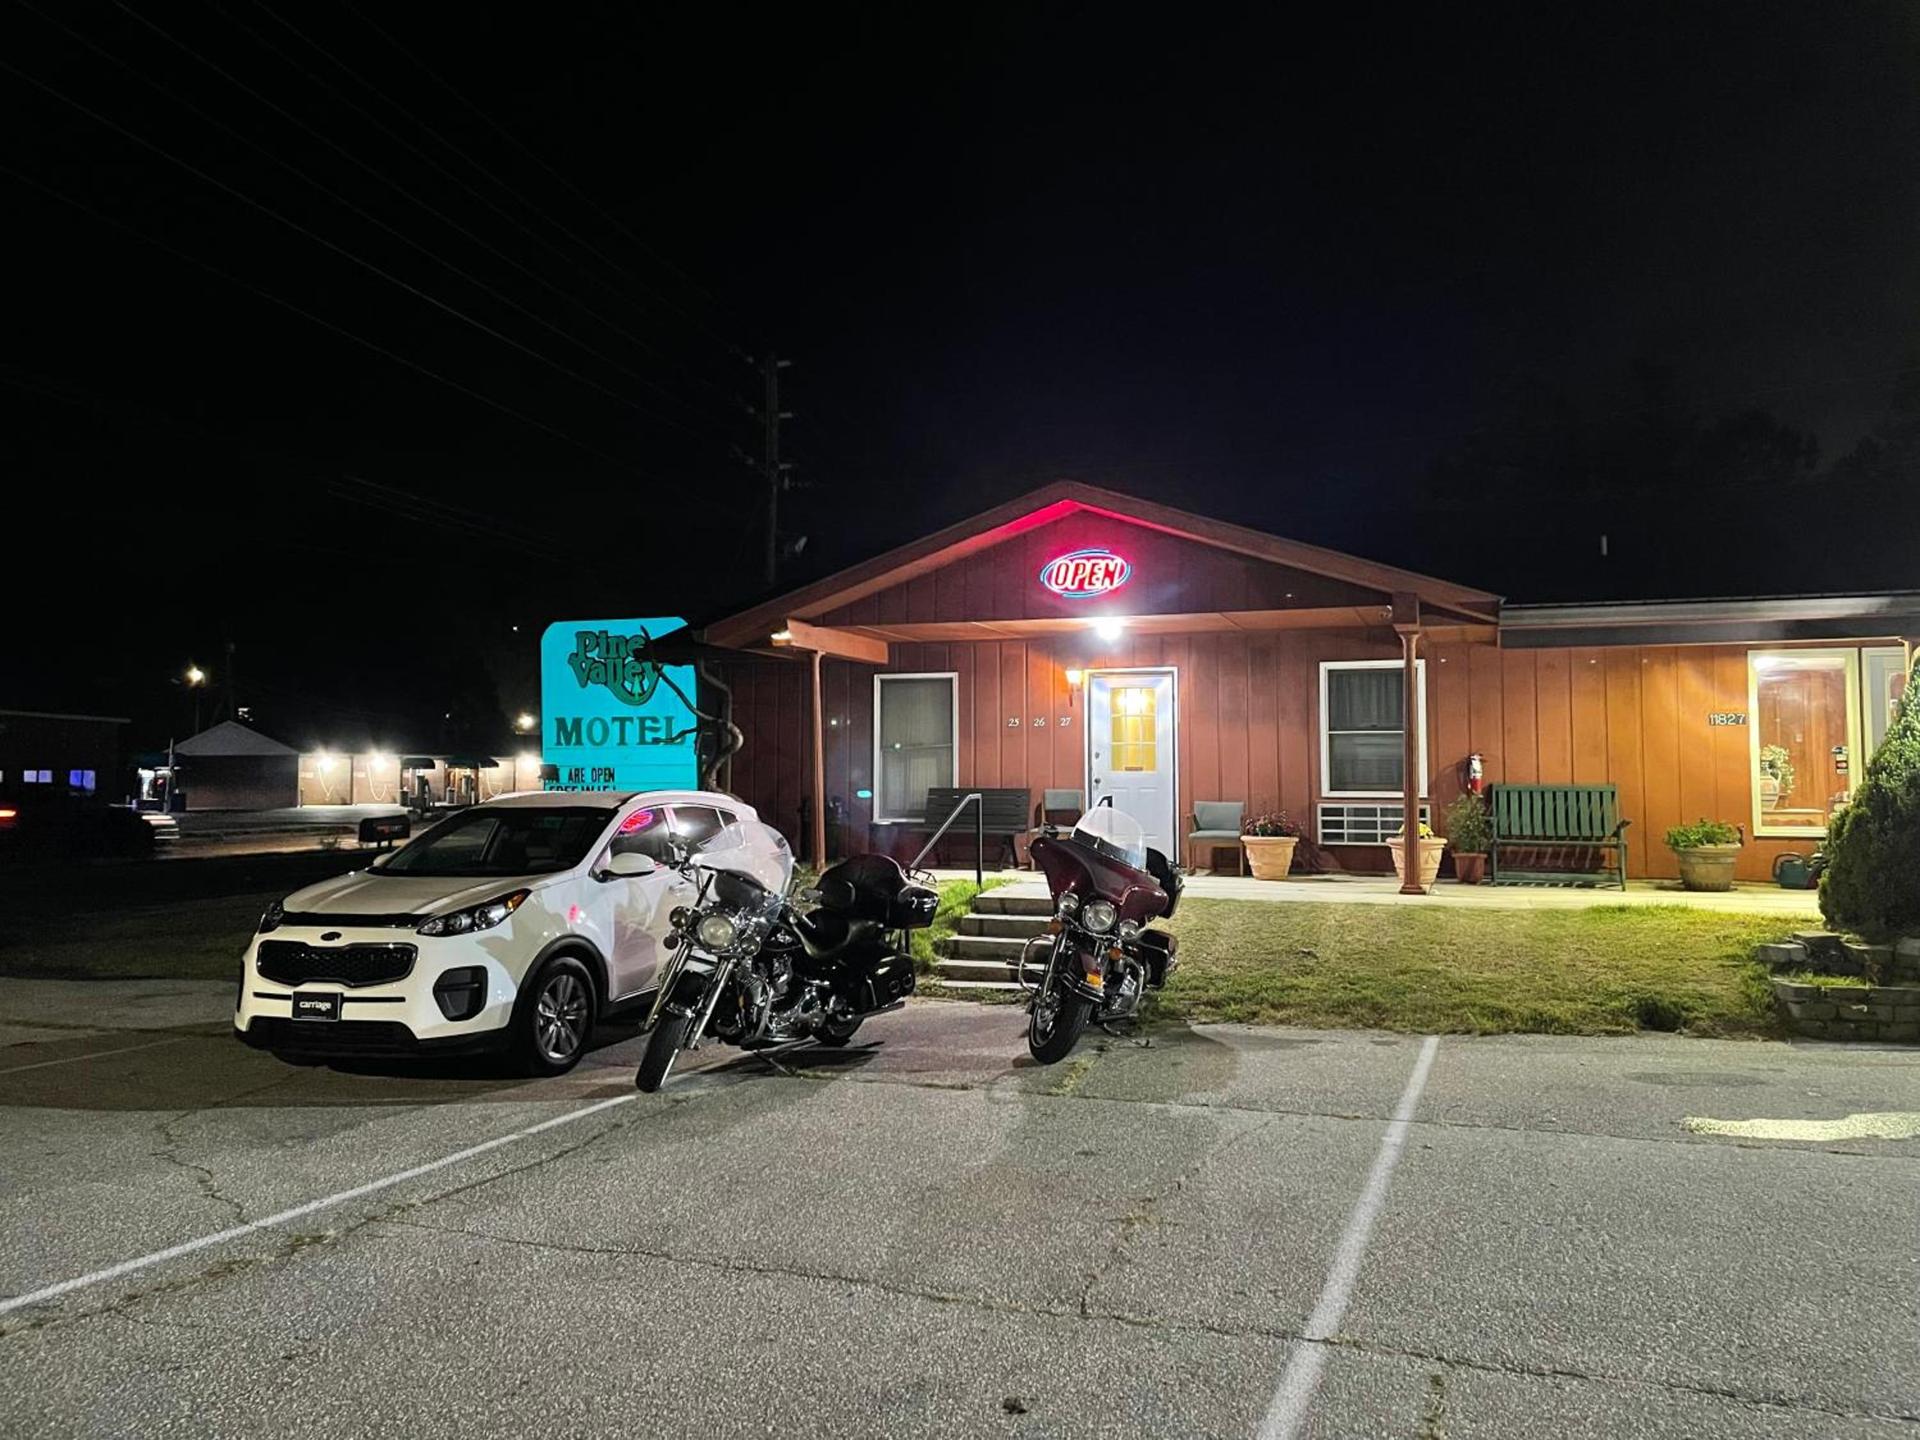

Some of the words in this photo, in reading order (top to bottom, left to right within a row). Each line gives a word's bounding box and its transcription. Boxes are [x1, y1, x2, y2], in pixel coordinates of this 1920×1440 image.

[1051, 558, 1122, 590] OPEN
[575, 630, 647, 659] Pine
[567, 652, 661, 706] Valley
[554, 716, 687, 746] MOTEL
[1008, 717, 1020, 727] 25
[1033, 717, 1045, 727] 26
[1060, 717, 1072, 727] 27
[1709, 713, 1746, 726] 11827
[568, 767, 586, 783] ARE
[591, 767, 615, 783] OPEN
